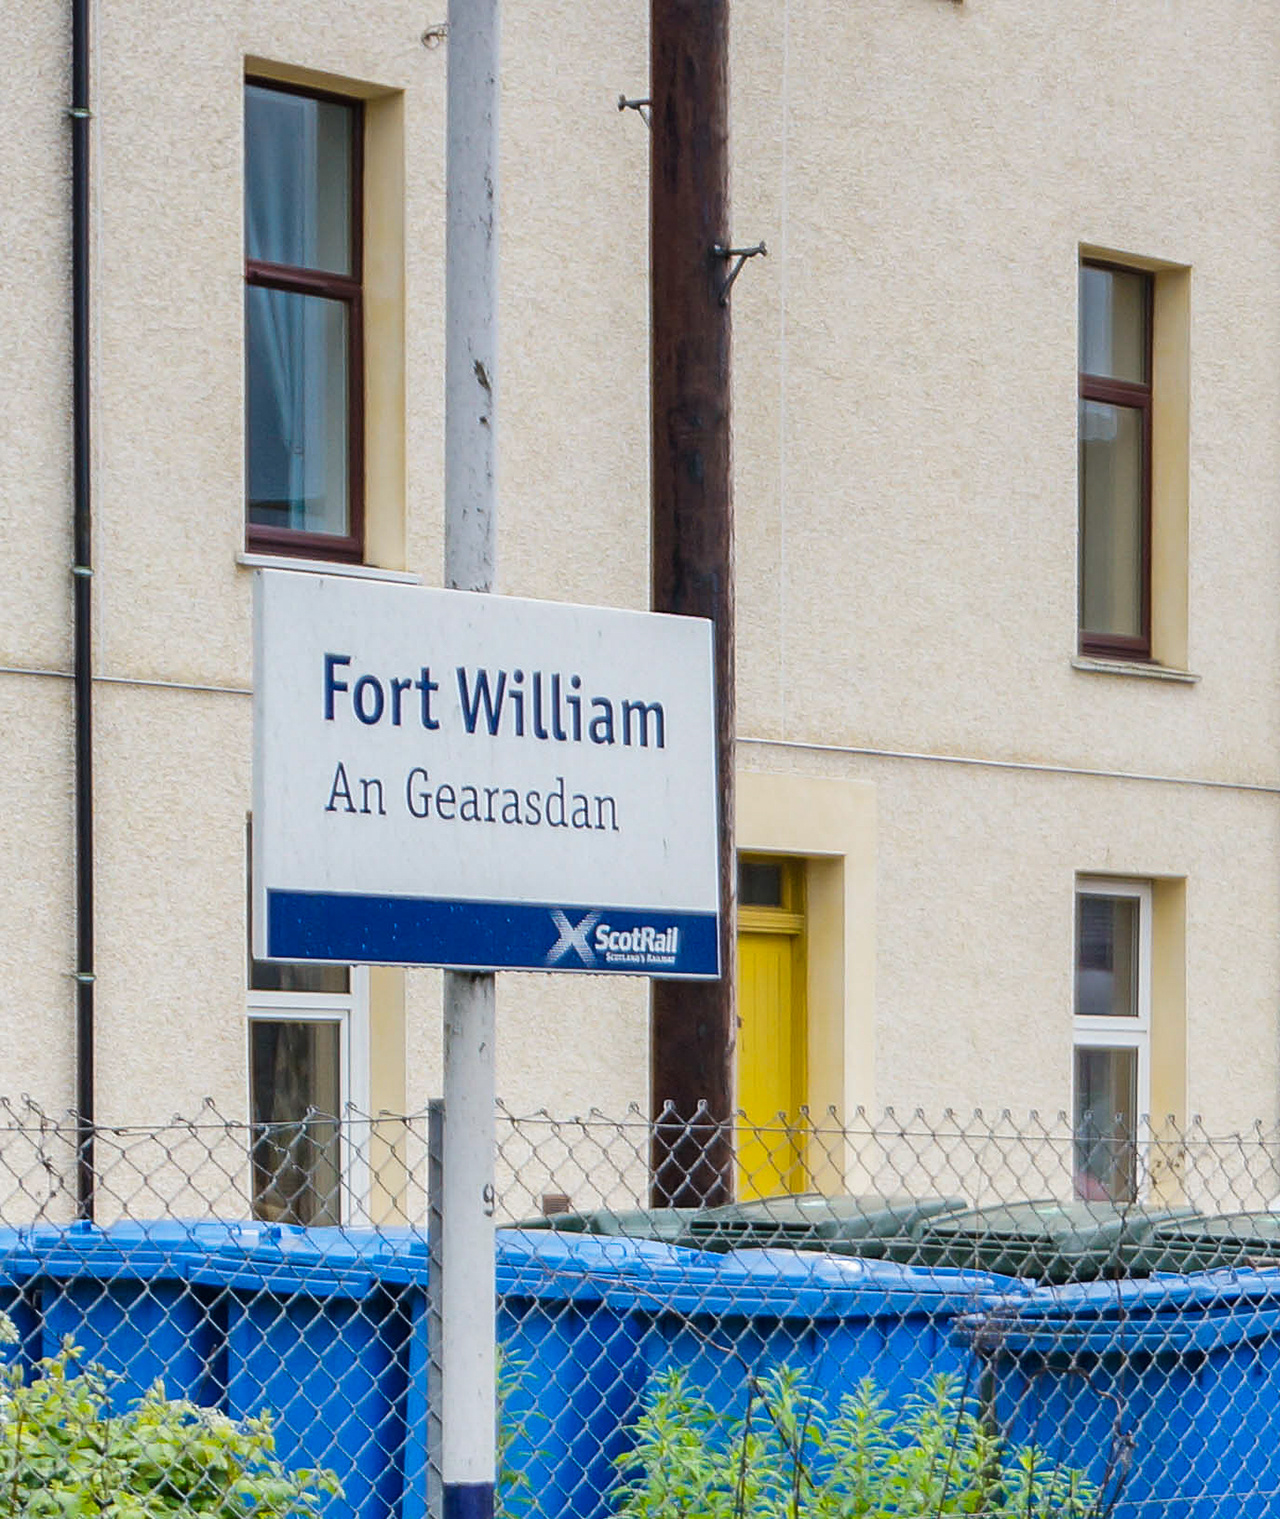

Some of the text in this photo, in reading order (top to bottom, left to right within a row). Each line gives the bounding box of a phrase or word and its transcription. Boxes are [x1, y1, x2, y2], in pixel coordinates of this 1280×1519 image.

[324, 653, 666, 748] Fort William
[325, 761, 620, 831] An Gearasdan
[595, 924, 678, 953] ScotRail
